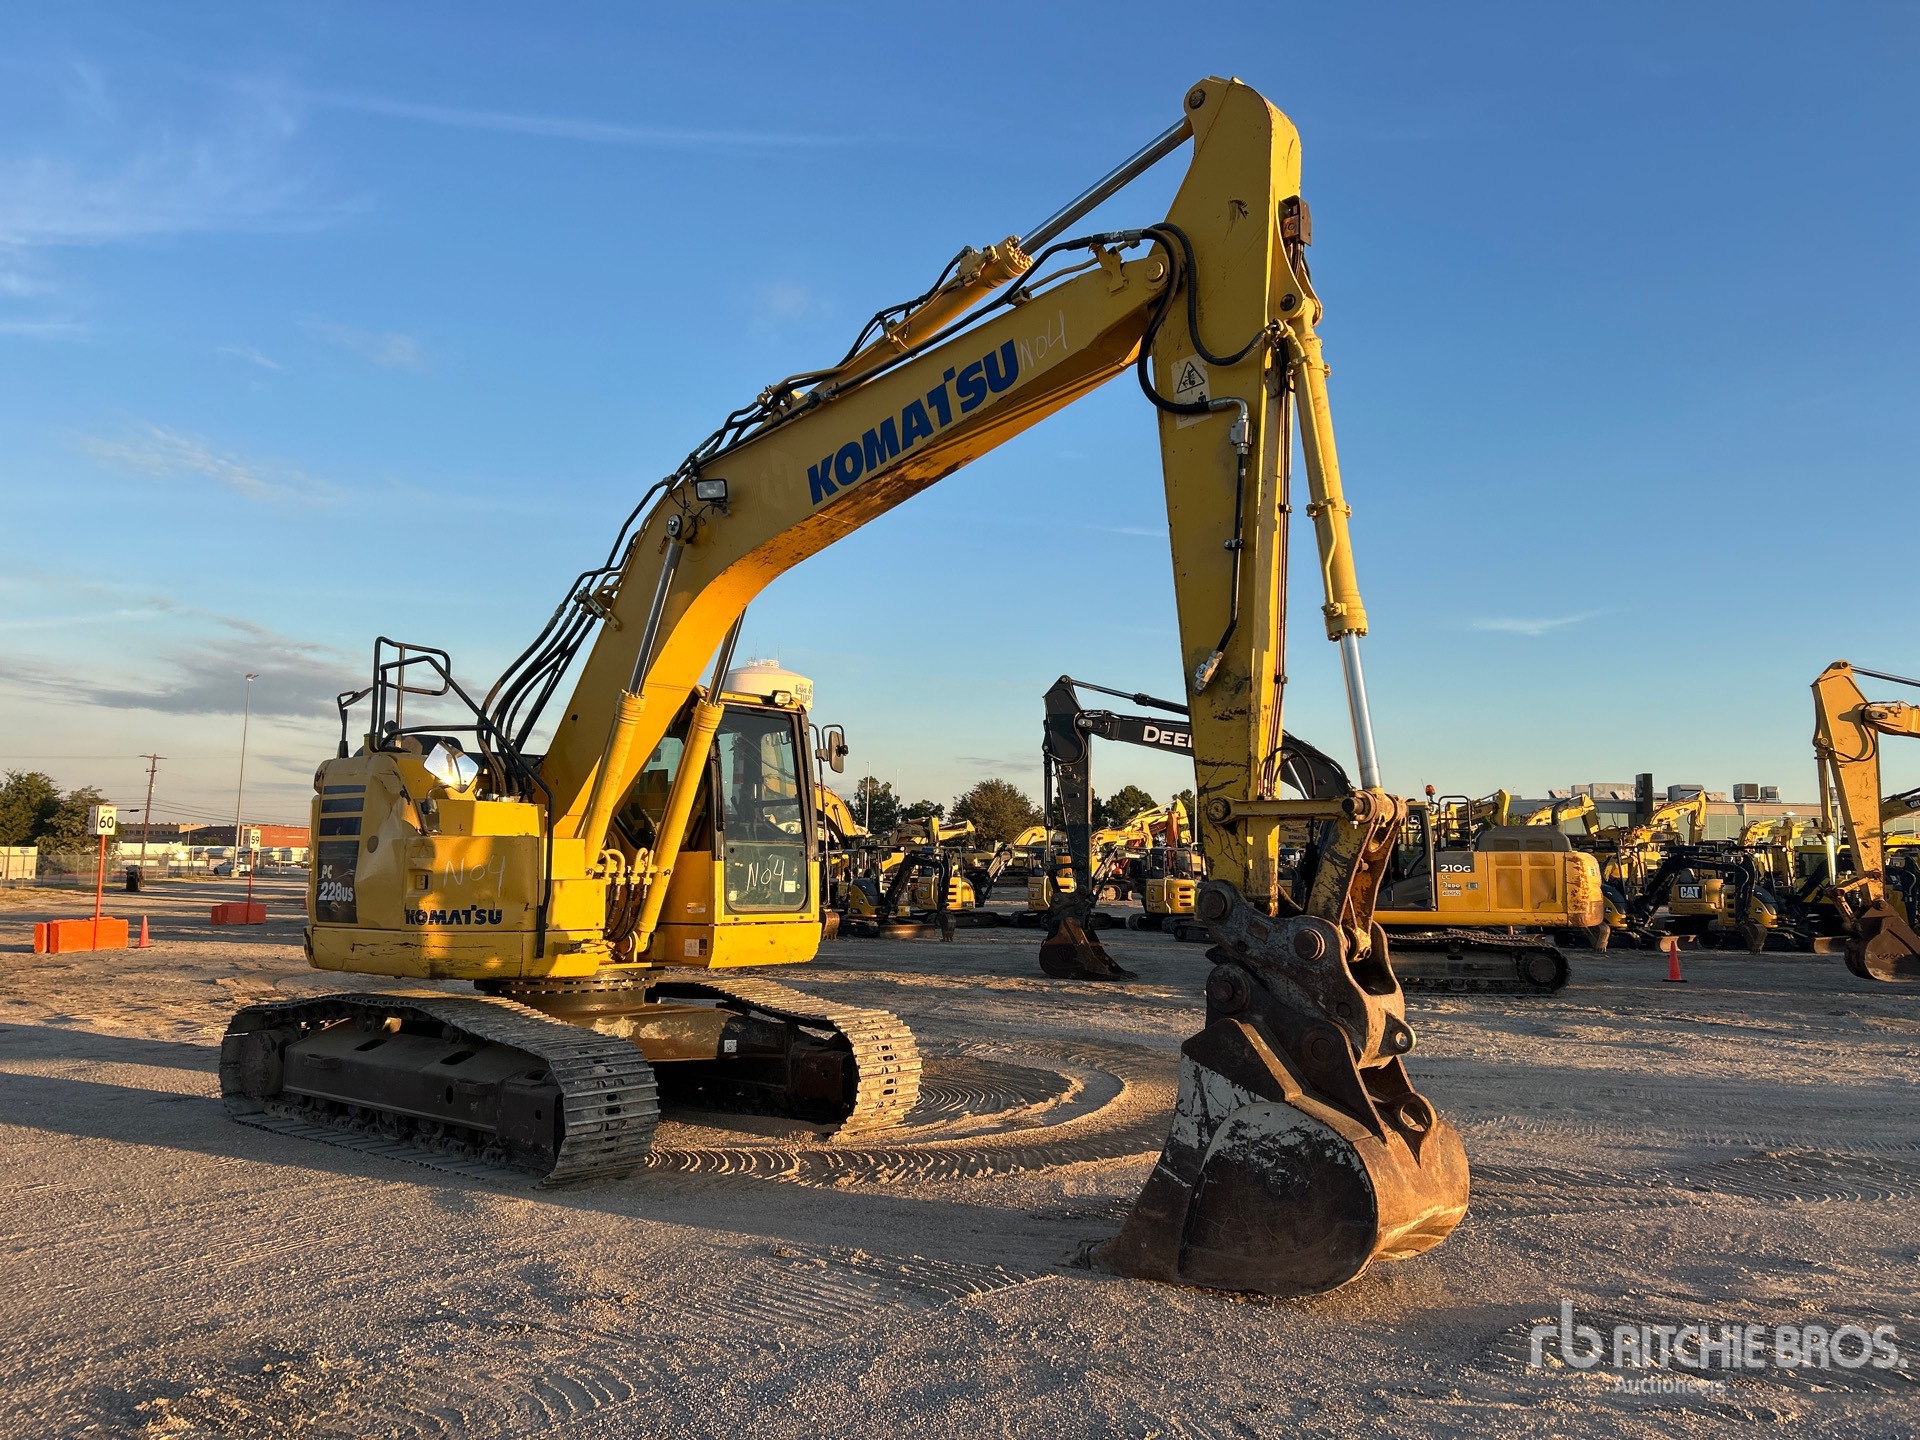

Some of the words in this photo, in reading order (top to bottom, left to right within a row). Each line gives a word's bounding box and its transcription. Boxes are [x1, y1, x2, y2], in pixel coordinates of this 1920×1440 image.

[807, 339, 1020, 506] KOMATSU
[99, 816, 114, 829] 60
[251, 836, 260, 844] 59
[321, 864, 333, 879] PC
[1440, 864, 1471, 873] 210G
[1680, 886, 1700, 899] CAT
[404, 904, 503, 926] KOMATSU
